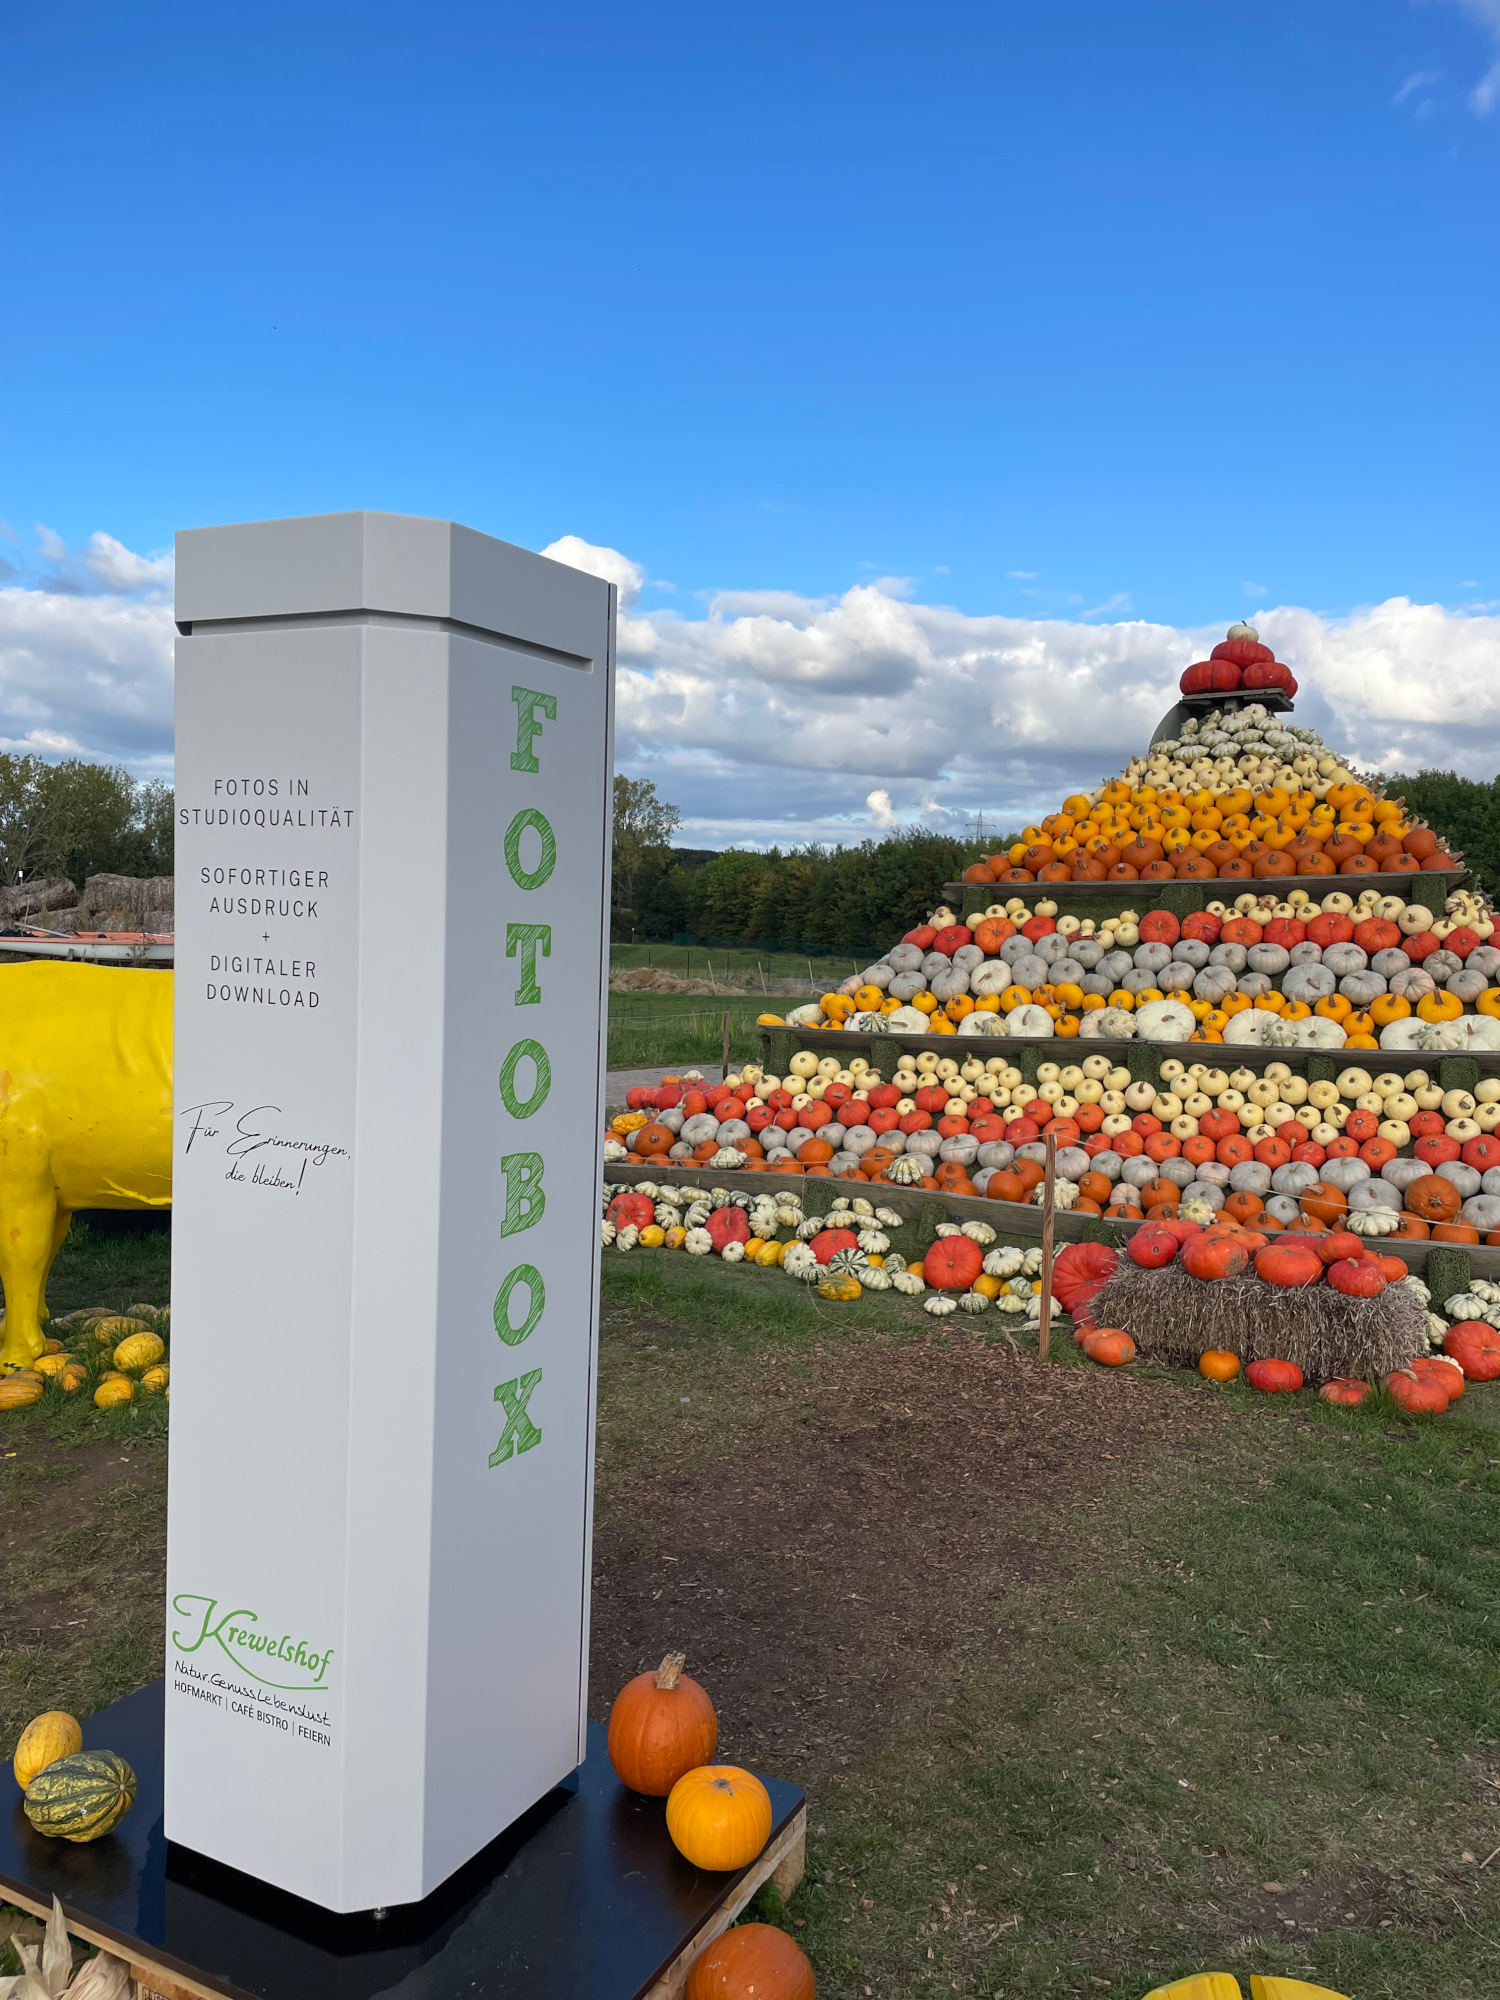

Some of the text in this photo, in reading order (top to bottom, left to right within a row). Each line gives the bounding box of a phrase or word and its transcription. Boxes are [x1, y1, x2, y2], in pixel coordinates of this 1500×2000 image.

[214, 779, 309, 796] FOTOS IN
[179, 806, 354, 828] STUDIOQUALITÄT
[200, 867, 329, 888] SOFORTIGER
[209, 897, 318, 918] AUSDRUCK
[210, 955, 316, 978] DIGITALER
[207, 984, 320, 1008] DOWNLOAD
[488, 685, 558, 1468] FOTOBOX
[180, 1101, 351, 1166] Für Erinnerungen,
[225, 1158, 307, 1196] die bleiben!
[172, 1593, 335, 1690] Krewelshof
[174, 1680, 331, 1746] HOFMARKT CAFÉ BISTRO FEIERN
